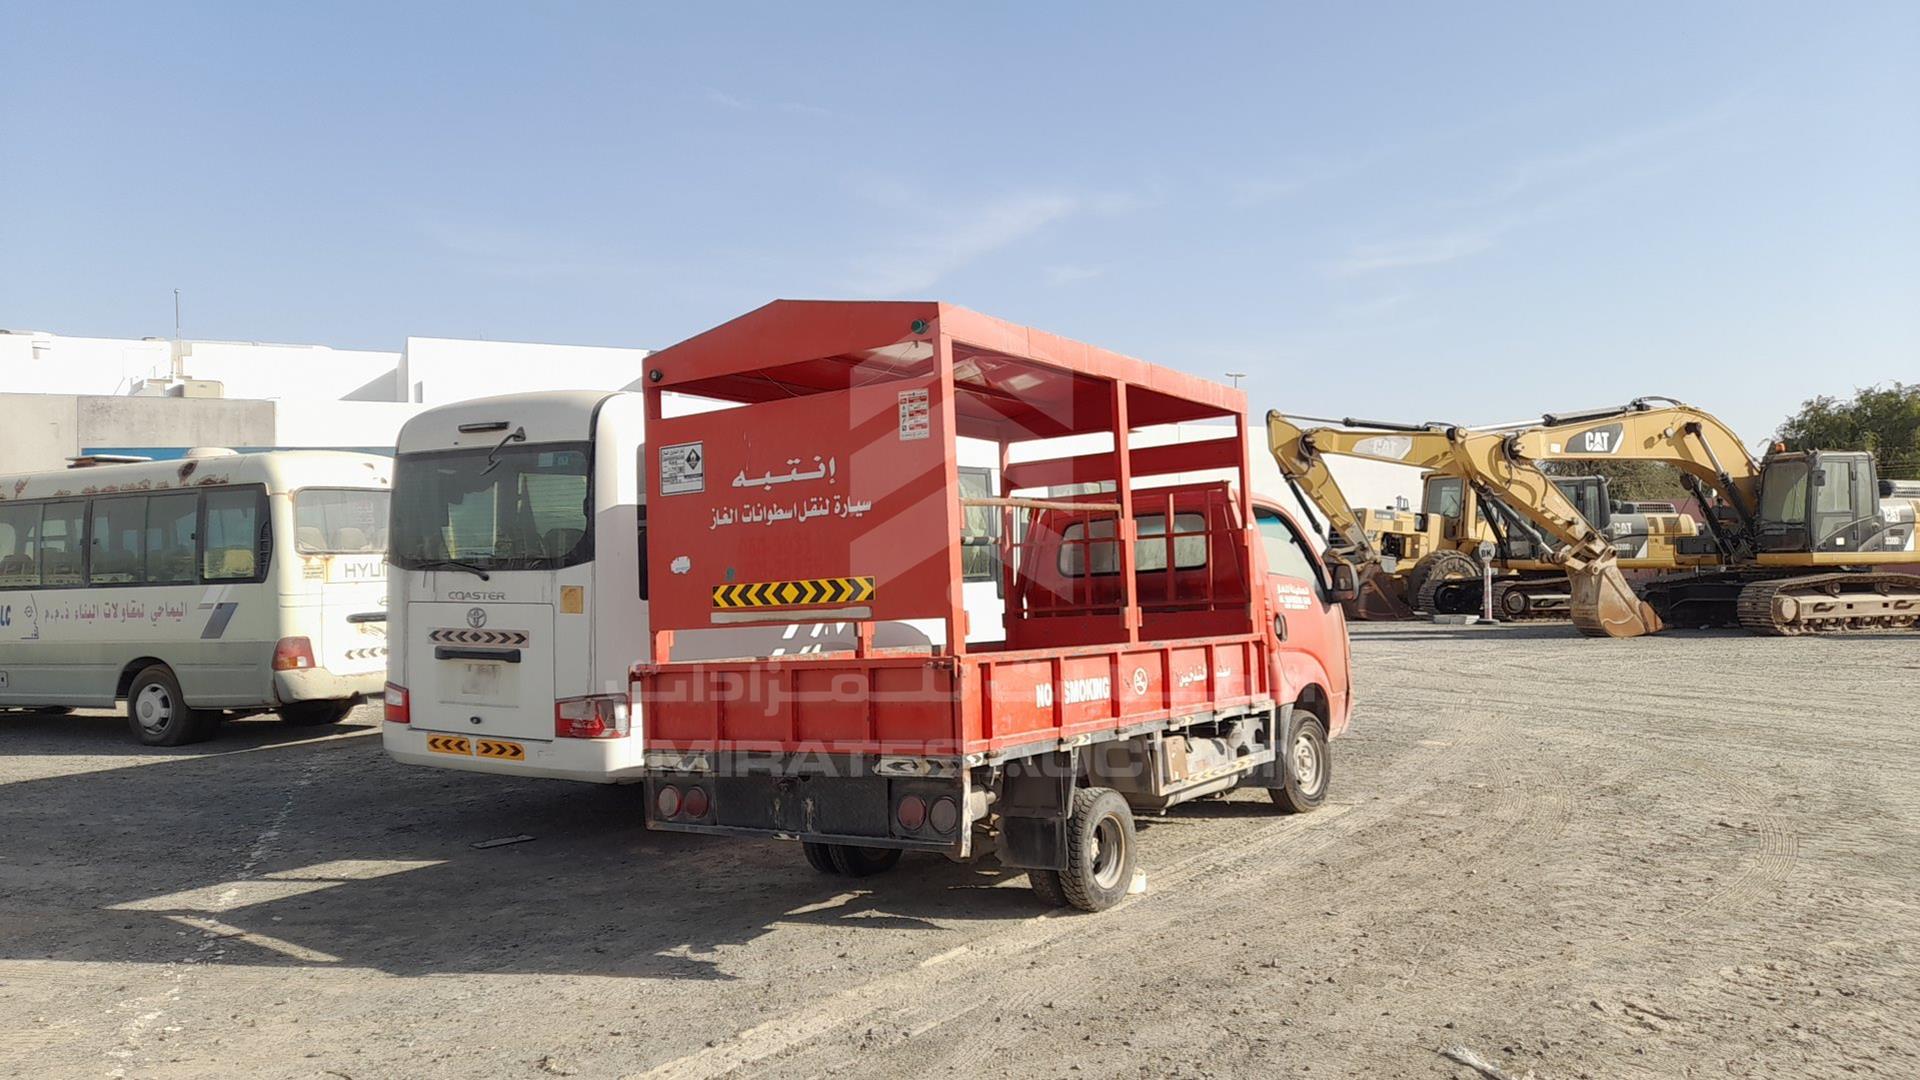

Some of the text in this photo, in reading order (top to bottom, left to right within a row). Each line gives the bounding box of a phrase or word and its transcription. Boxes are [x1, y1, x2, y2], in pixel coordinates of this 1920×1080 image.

[1585, 431, 1610, 452] CAT
[709, 506, 739, 530] الغاز
[798, 498, 830, 523] لنقل
[833, 494, 872, 518] سيارة
[1613, 521, 1633, 535] CAT
[447, 590, 507, 601] COASTER
[1036, 682, 1053, 708] NO
[1063, 676, 1110, 705] SMOKING
